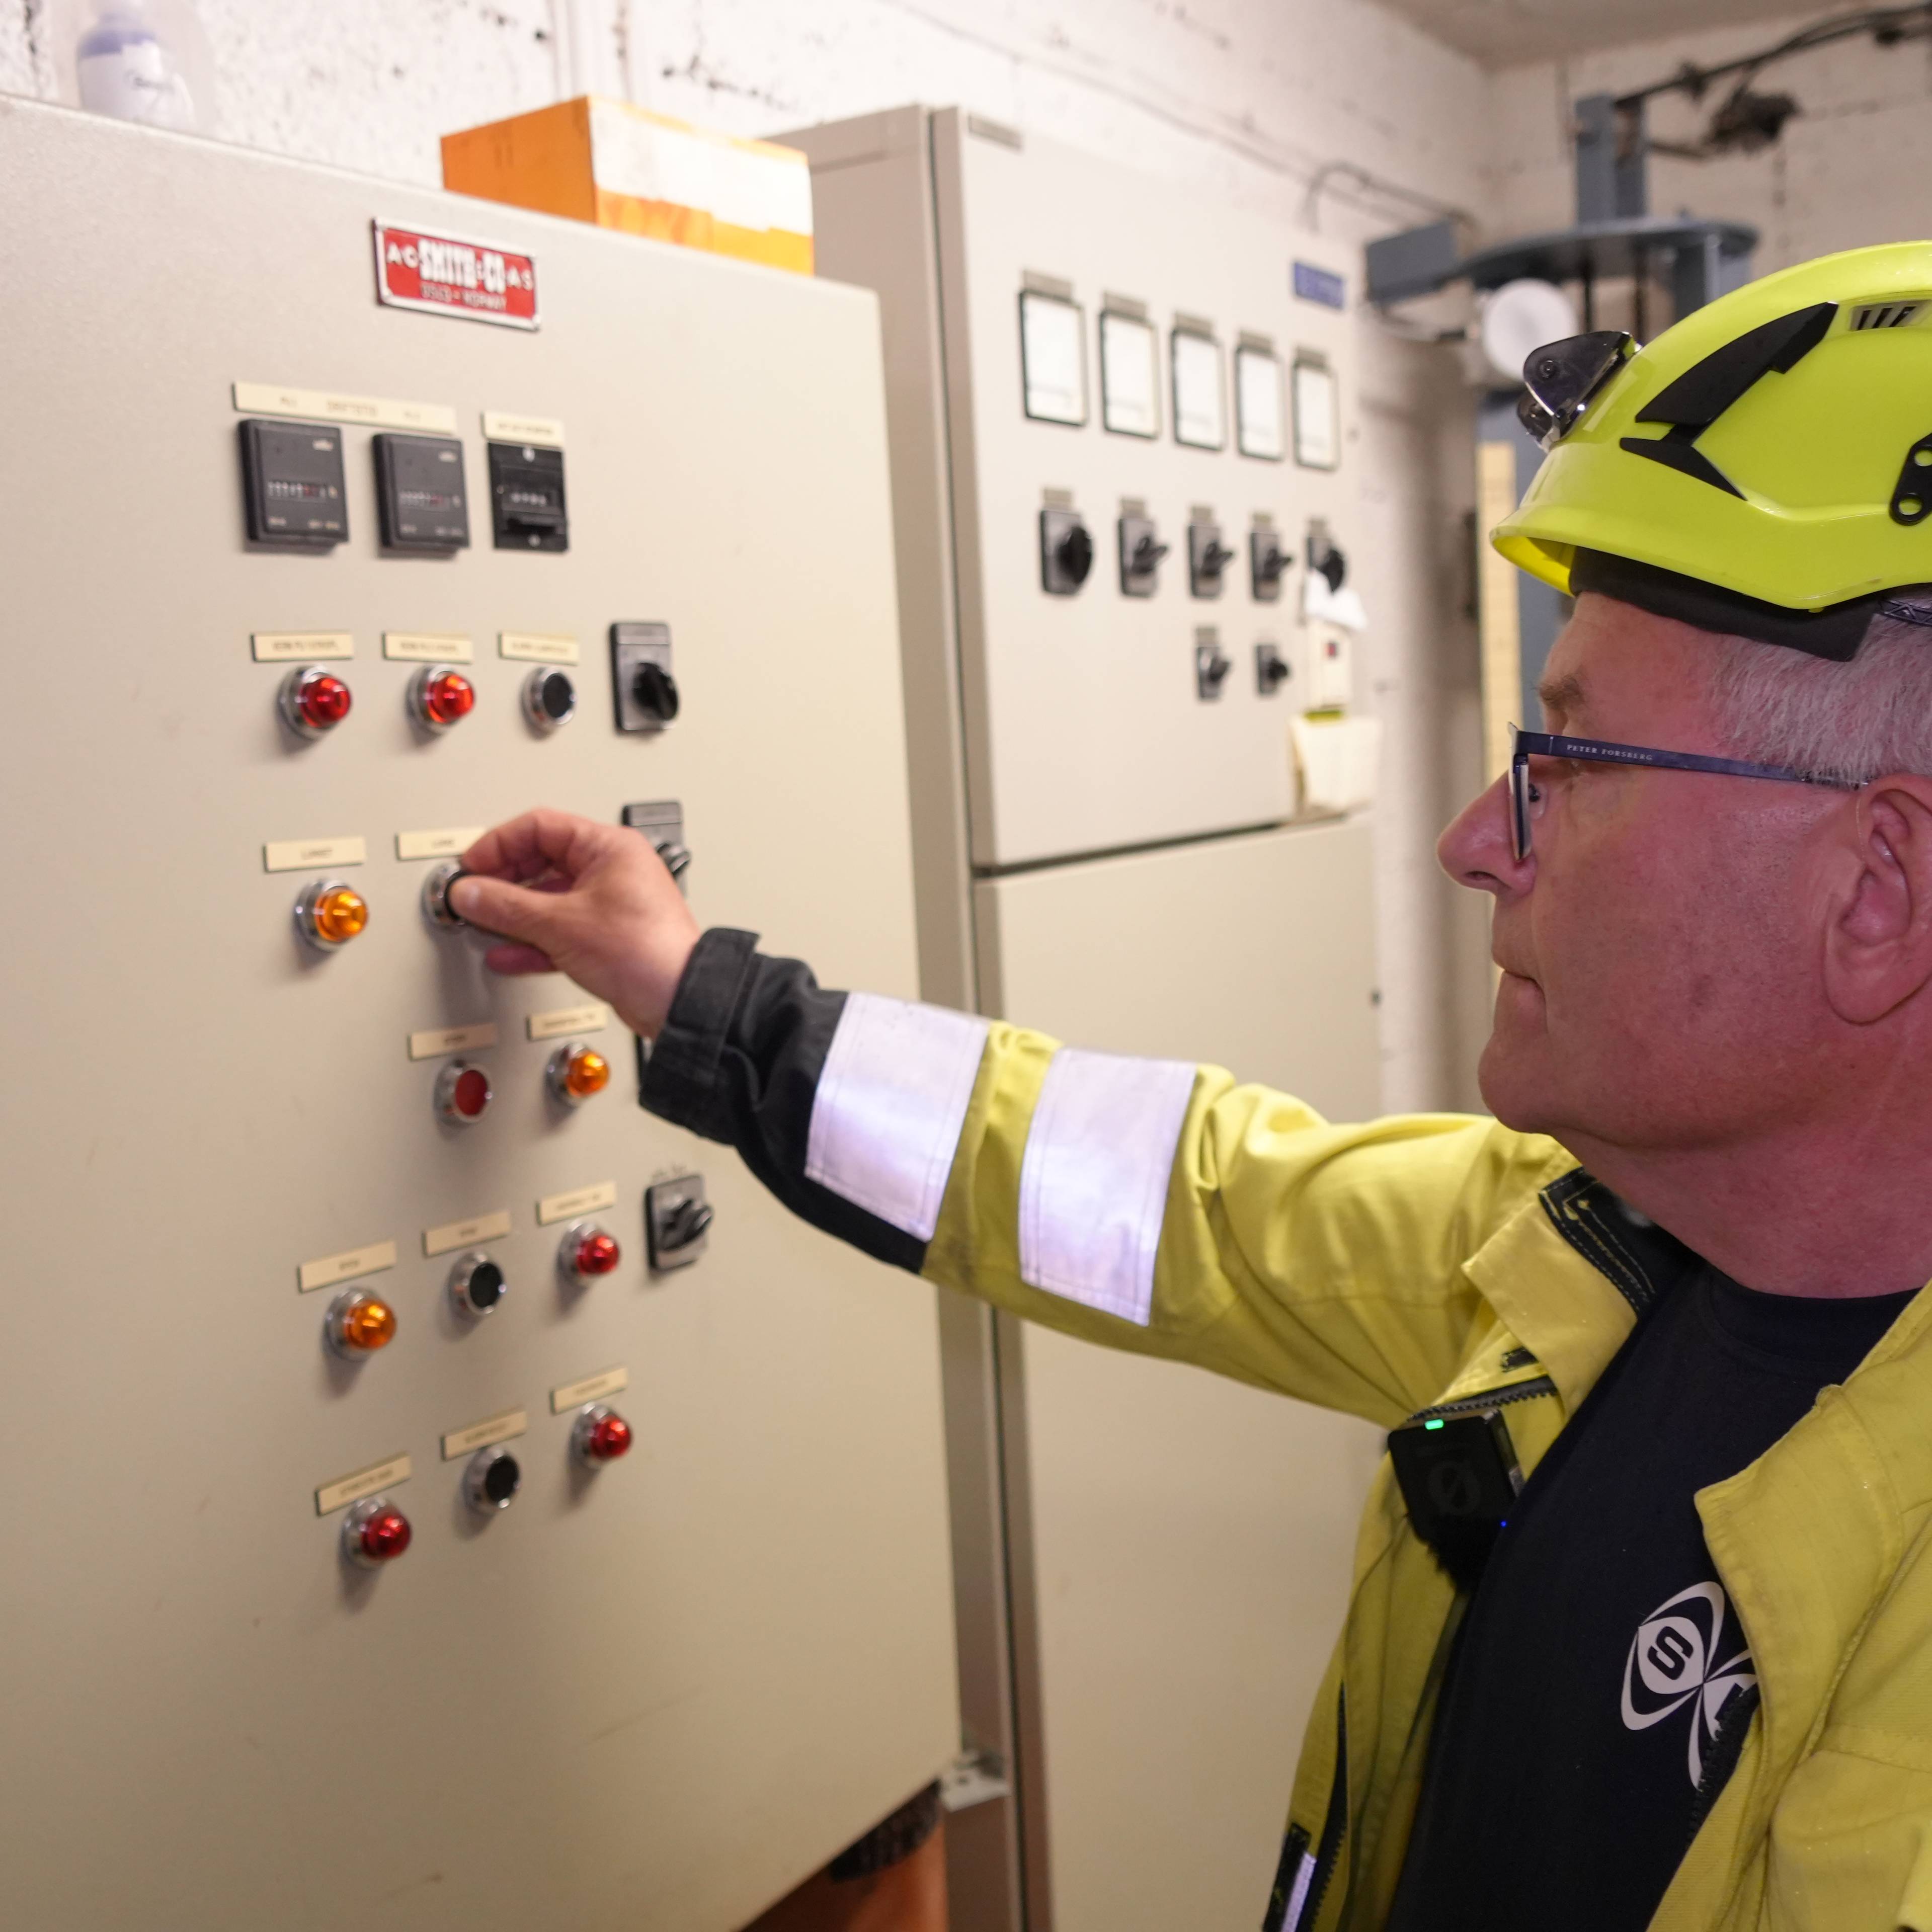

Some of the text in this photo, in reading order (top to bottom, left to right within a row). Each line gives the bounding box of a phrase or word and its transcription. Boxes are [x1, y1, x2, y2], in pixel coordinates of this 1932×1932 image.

[1567, 745, 1653, 760] PETER FORSBERG
[1647, 1626, 1694, 1680] S
